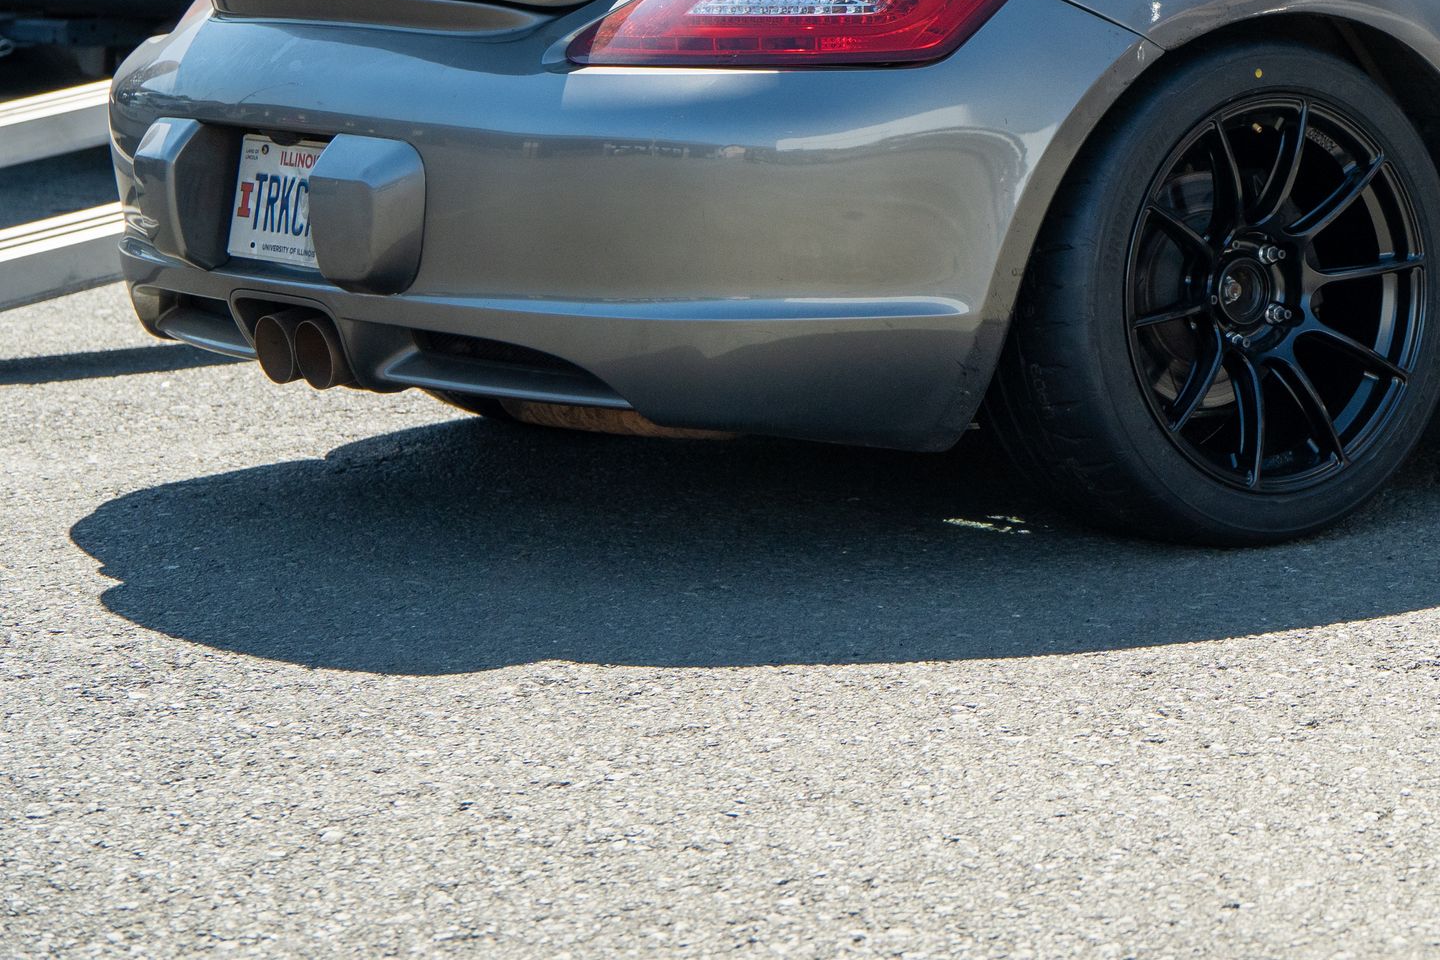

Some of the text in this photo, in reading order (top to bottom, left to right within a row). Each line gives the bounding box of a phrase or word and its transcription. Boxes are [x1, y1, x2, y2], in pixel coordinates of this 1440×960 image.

[280, 150, 320, 169] ILLINOI
[252, 172, 312, 237] TRKC
[262, 243, 289, 254] UNIVERSITY
[290, 247, 296, 255] OF
